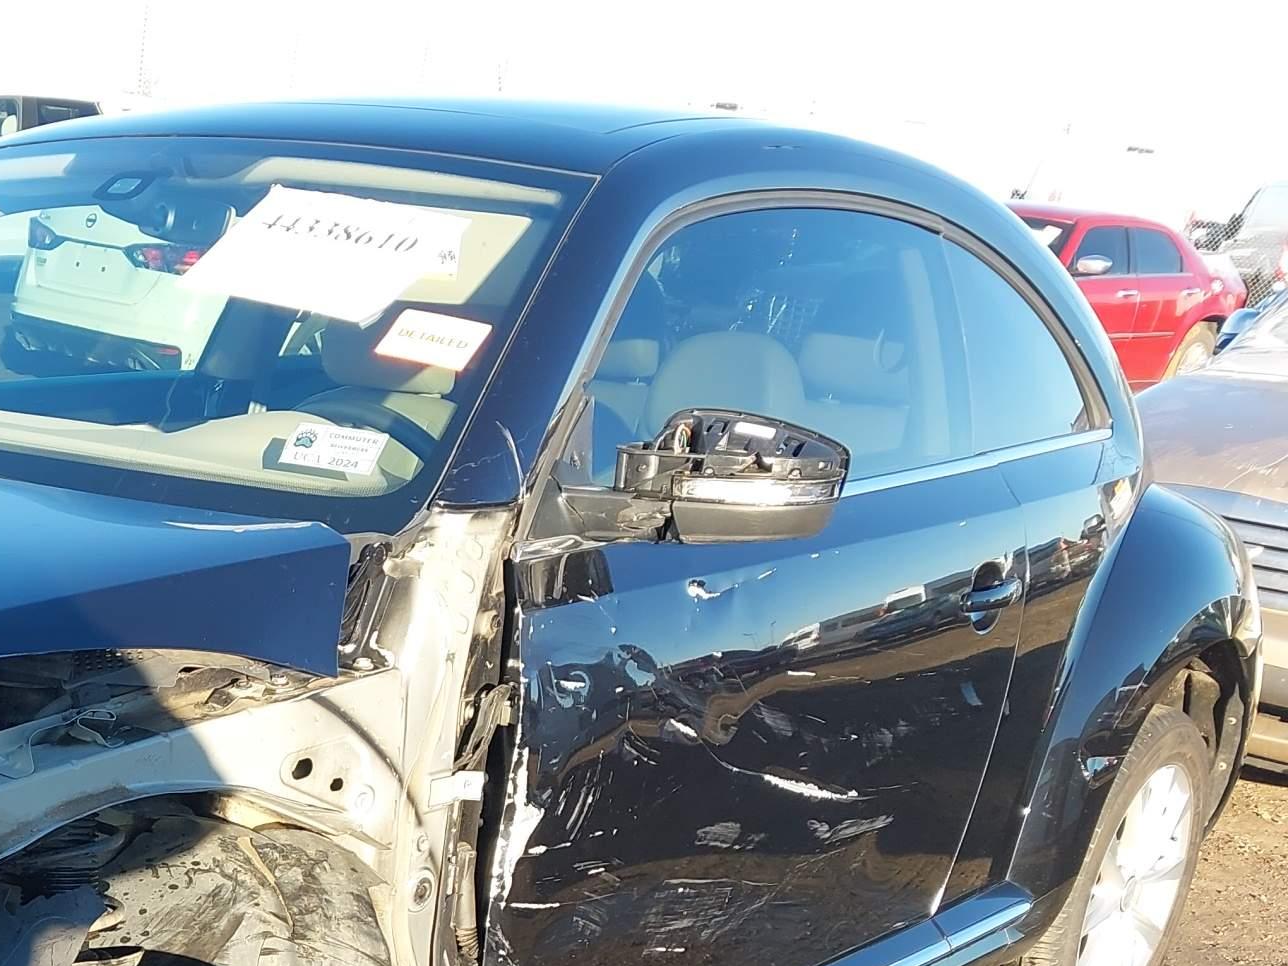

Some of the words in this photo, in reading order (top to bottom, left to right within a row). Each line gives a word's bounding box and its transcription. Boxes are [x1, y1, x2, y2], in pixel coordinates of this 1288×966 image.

[261, 213, 420, 253] 44338610
[397, 327, 469, 350] DETAILED
[329, 432, 379, 445] COMMUTER
[327, 456, 359, 469] 2024
